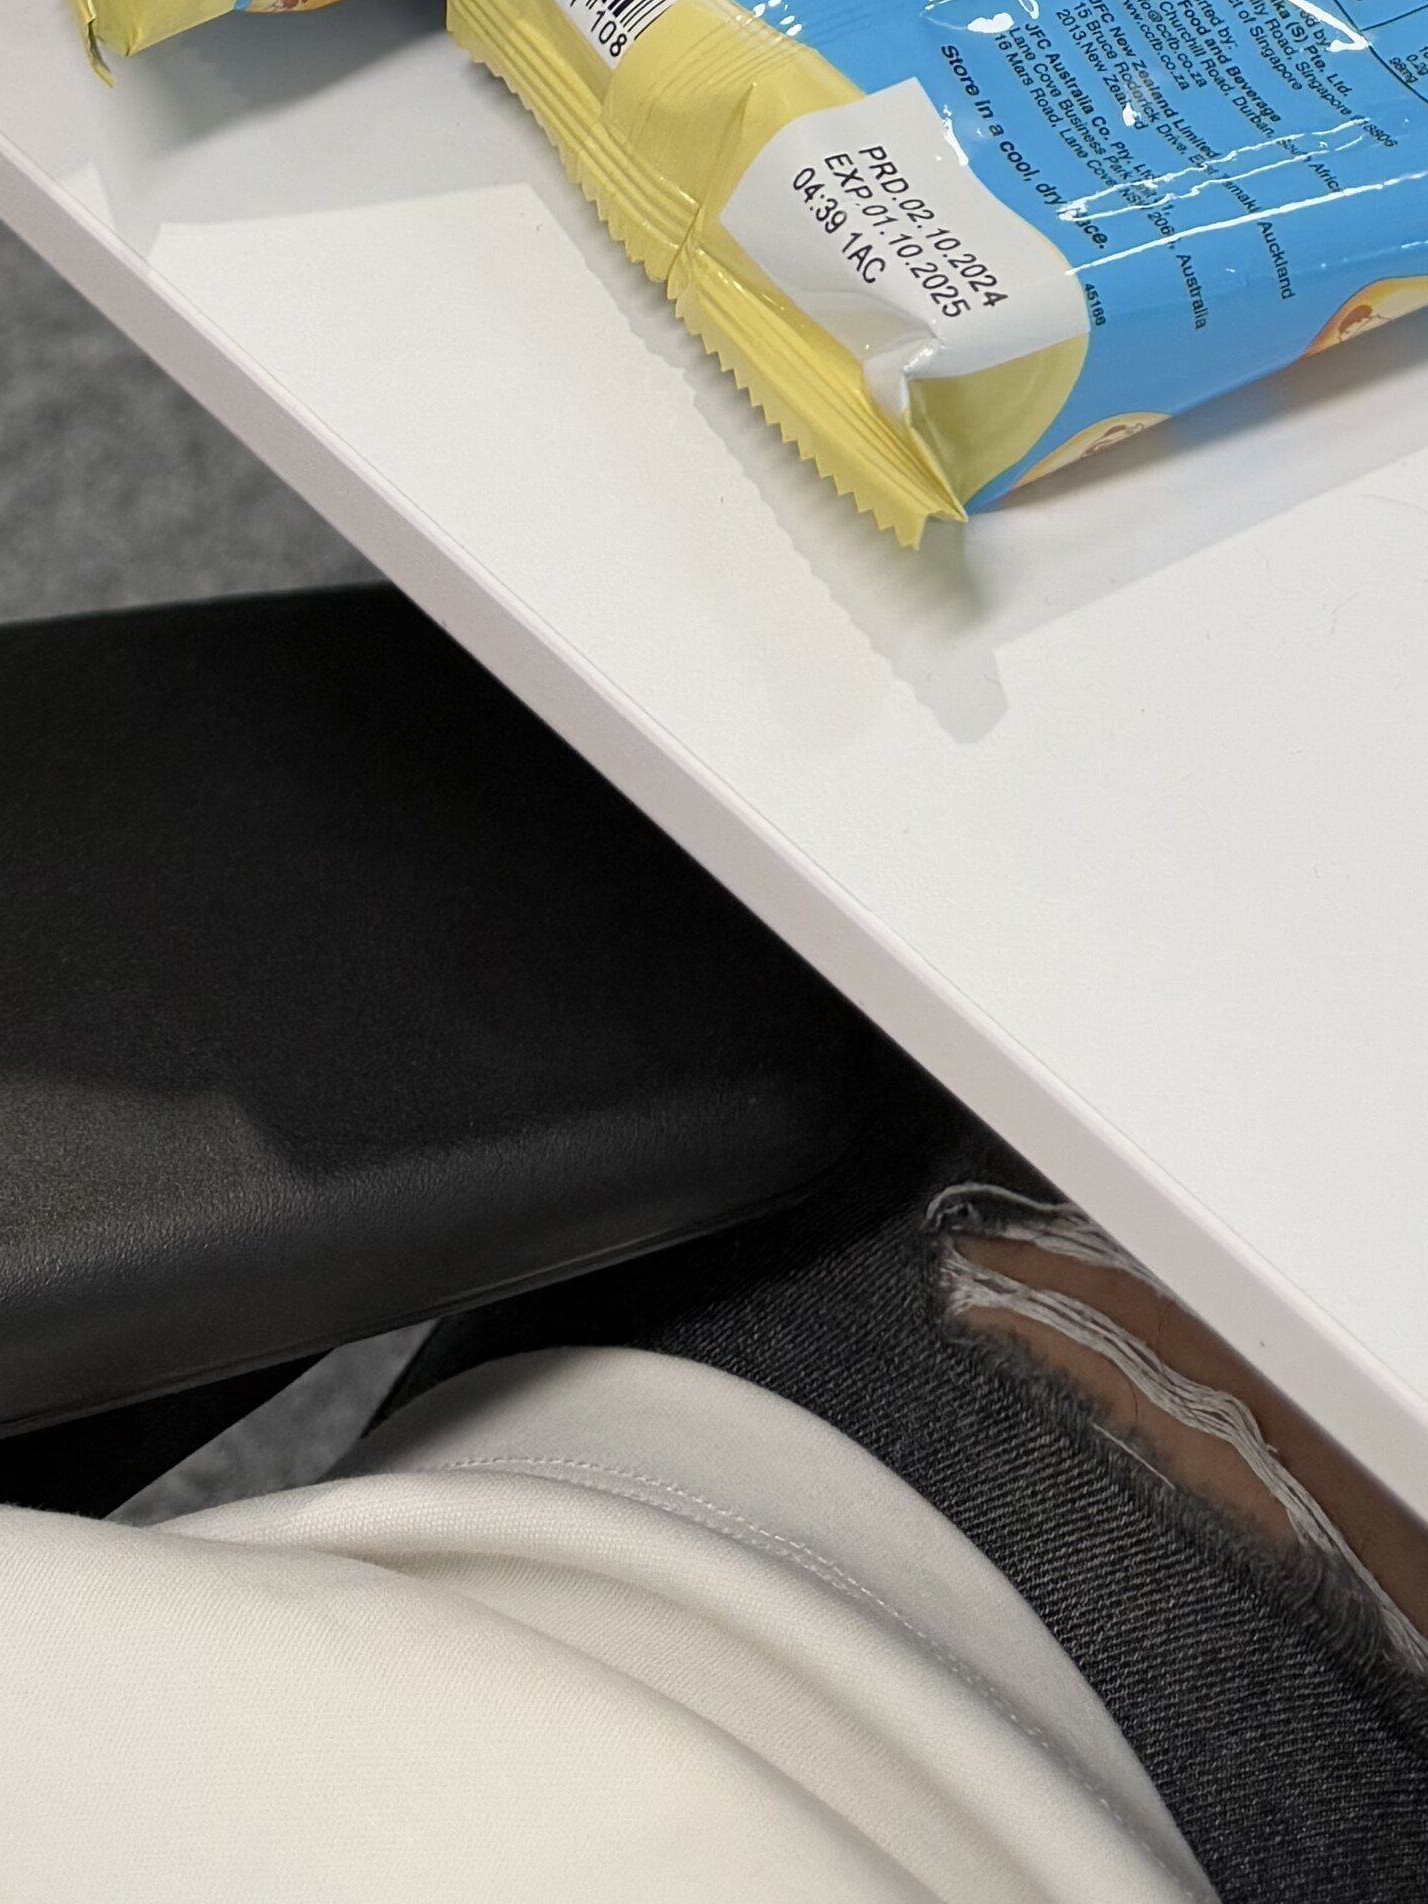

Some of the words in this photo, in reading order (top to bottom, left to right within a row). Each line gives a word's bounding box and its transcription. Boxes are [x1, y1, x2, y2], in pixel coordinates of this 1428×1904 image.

[1158, 0, 1207, 58] Churchill
[1200, 58, 1236, 96] Road,
[1204, 38, 1233, 64] and
[1225, 66, 1282, 122] Beverage
[1216, 26, 1238, 50] by:
[1249, 25, 1303, 90] Singapore
[1264, 17, 1299, 60] Road,
[1294, 60, 1352, 116] Singapore
[1284, 22, 1309, 44] (S)
[1303, 44, 1326, 73] Pte.
[1326, 72, 1353, 98] Ltd.
[940, 45, 980, 96] Store
[974, 99, 994, 119] in
[999, 140, 1040, 182] cool,
[1035, 182, 1068, 205] dry
[1044, 53, 1094, 115] Australia
[1091, 116, 1110, 141] Co.
[1110, 141, 1134, 164] Pty.
[1058, 98, 1107, 156] Business
[1108, 26, 1137, 57] New
[1130, 59, 1180, 118] Zealand
[1172, 118, 1222, 162] Limited
[1006, 52, 1034, 86] Mars
[1030, 87, 1064, 128] Road,
[1175, 254, 1208, 330] Australia
[1085, 19, 1118, 60] Bruce
[1112, 60, 1174, 124] Roderick
[1256, 222, 1296, 300] Auckland
[792, 167, 848, 234] 04:39
[842, 232, 886, 284] 1AC
[824, 153, 971, 318] EXP.01.10.2025
[858, 146, 1008, 307] PRD.02.10.2024
